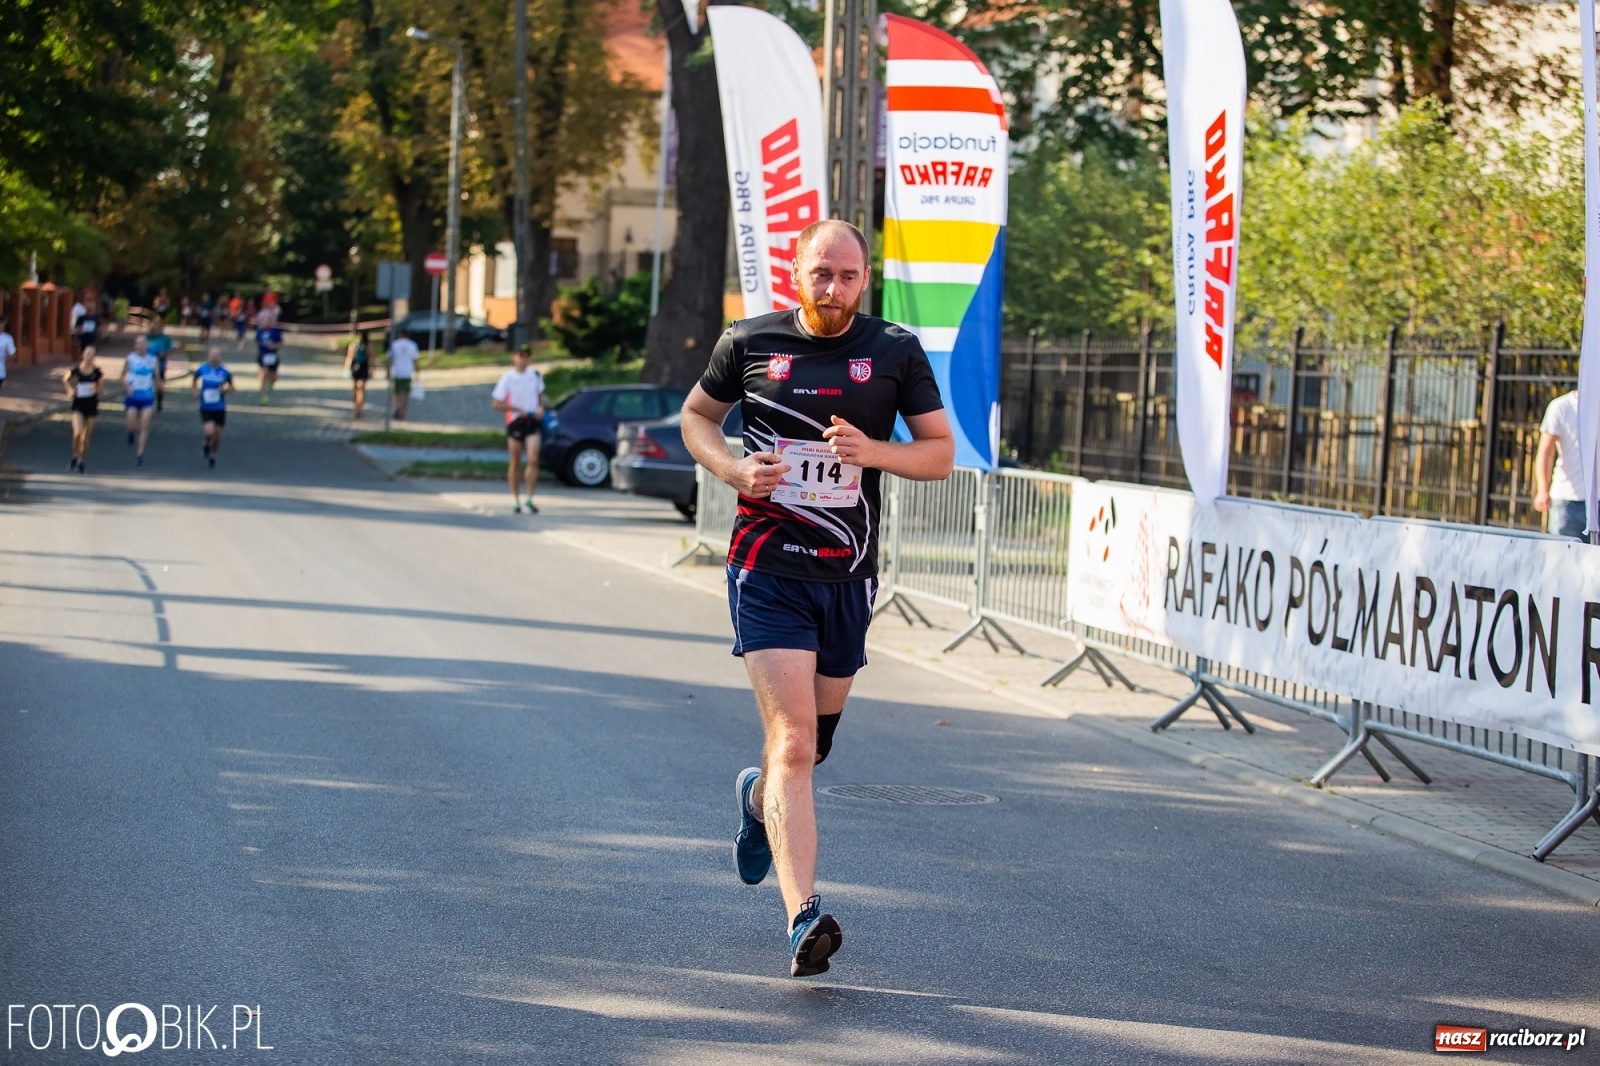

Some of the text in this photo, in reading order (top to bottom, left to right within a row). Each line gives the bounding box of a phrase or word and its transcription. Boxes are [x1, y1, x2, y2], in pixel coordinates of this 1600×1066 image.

[801, 460, 842, 484] 114
[1164, 536, 1275, 632] RAFAKO
[1285, 538, 1560, 699] PÓŁMARATON
